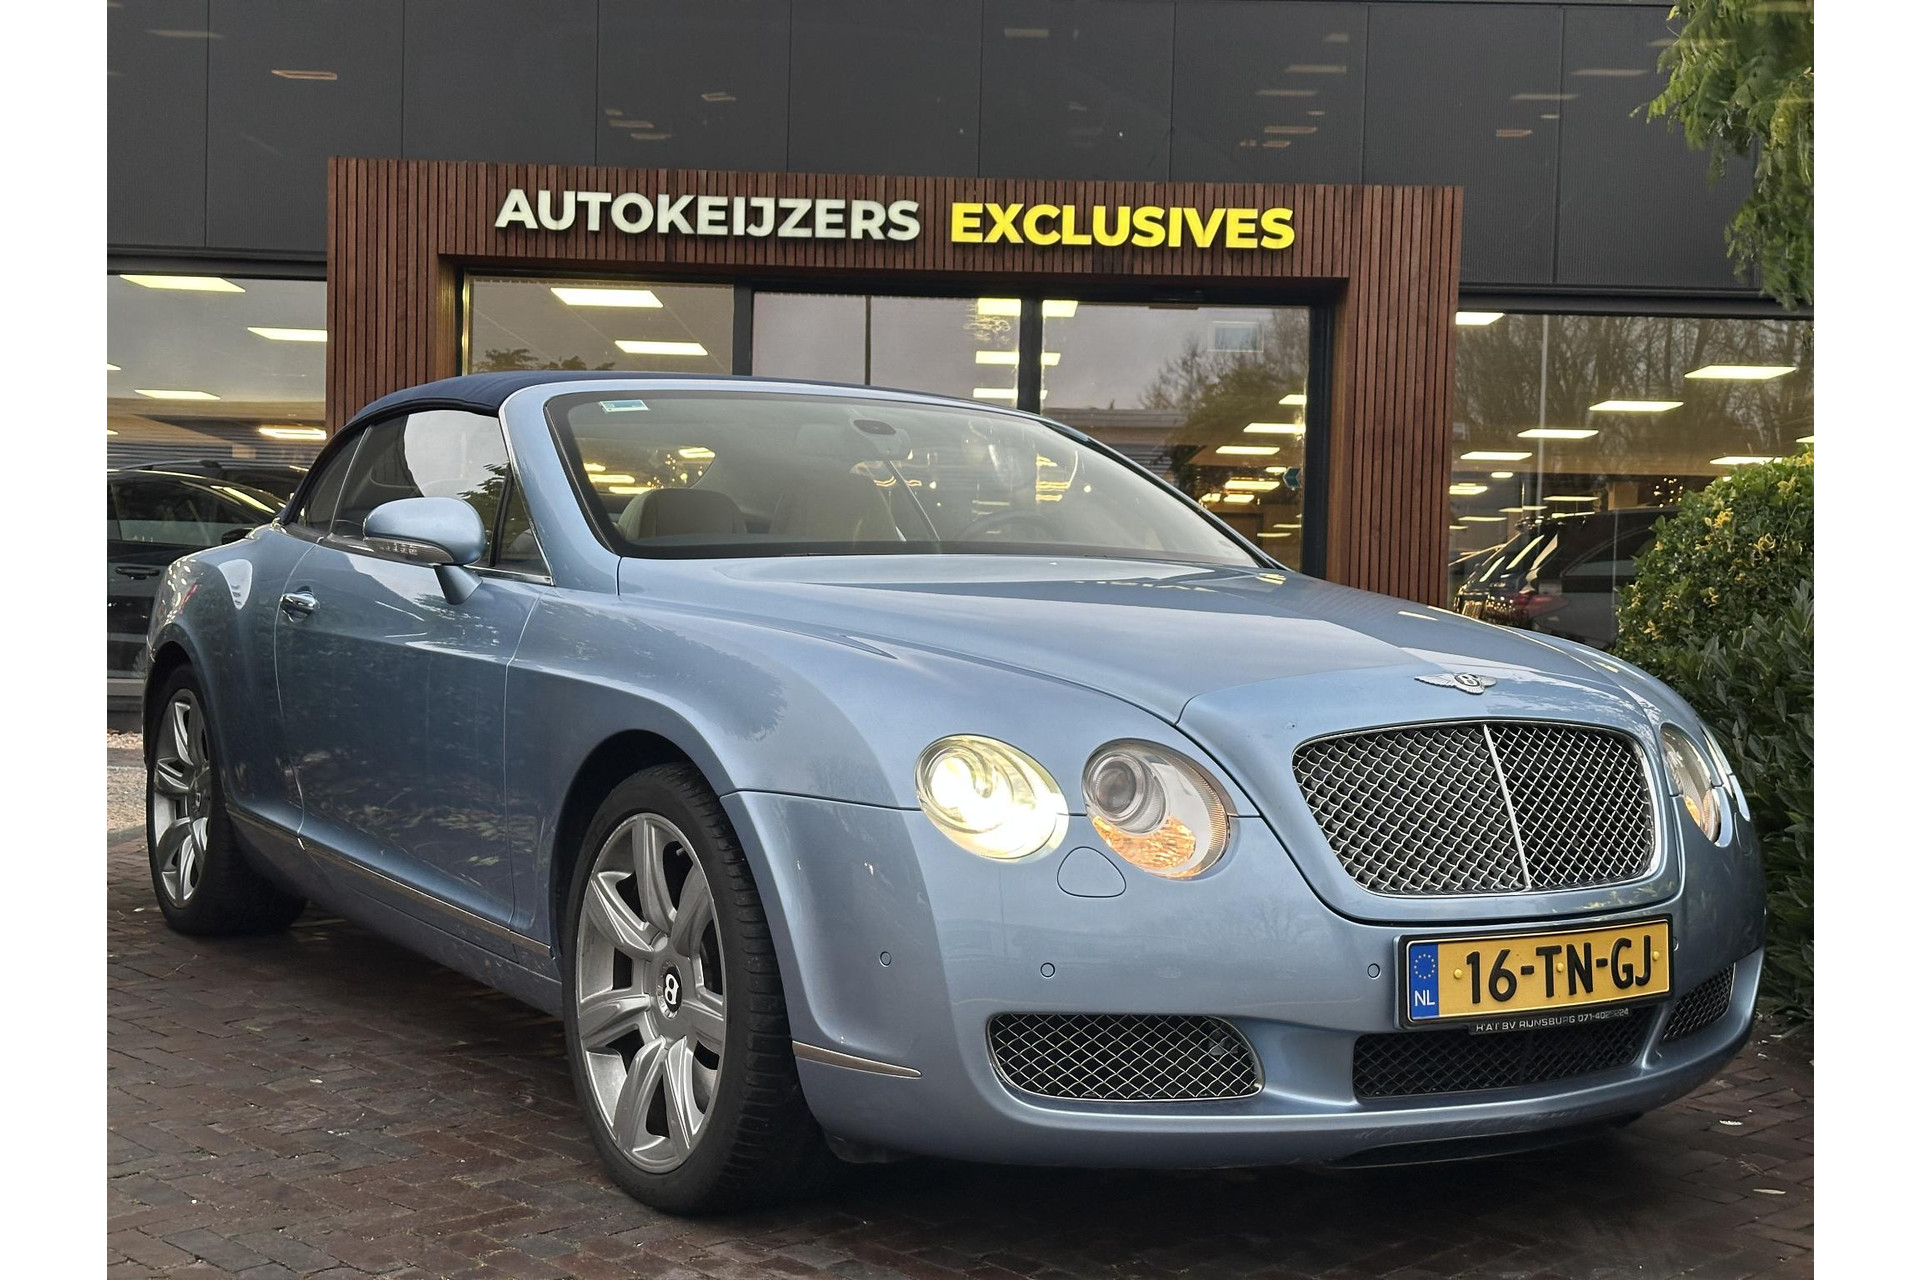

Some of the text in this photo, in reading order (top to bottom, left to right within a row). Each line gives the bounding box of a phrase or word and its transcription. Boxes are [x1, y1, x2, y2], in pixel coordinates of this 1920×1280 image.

[494, 188, 1295, 250] AUTOKEIJZERS EXCLUSIVES
[1466, 934, 1652, 1004] 16-TN-GJ
[1414, 989, 1436, 1007] NL
[1501, 1020, 1517, 1031] BV
[1518, 1015, 1576, 1029] RIJNSBURG
